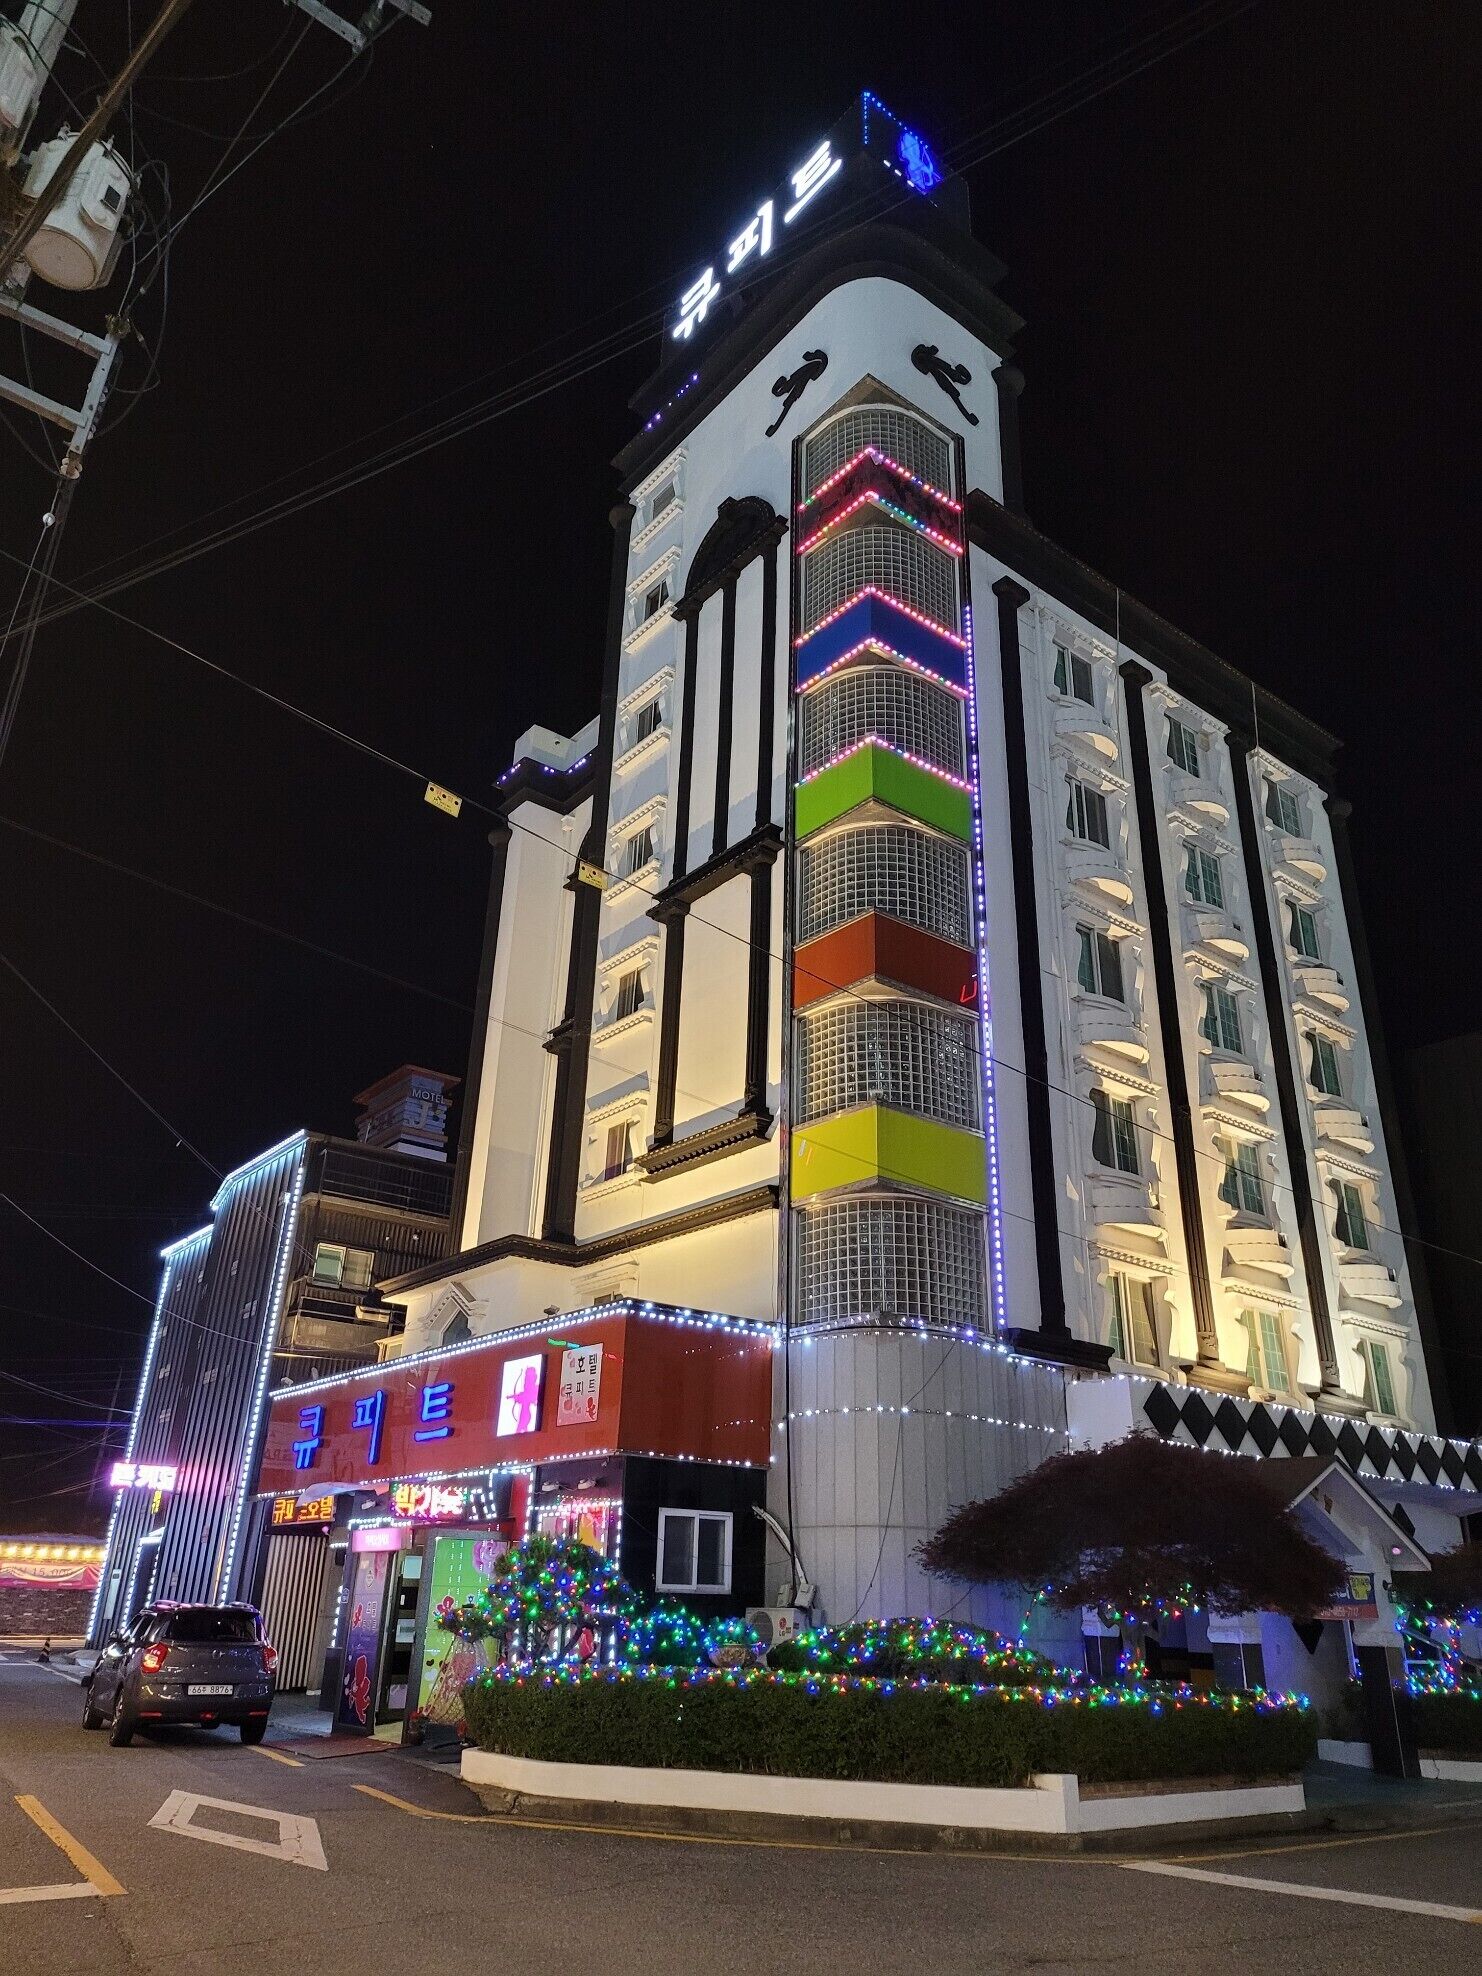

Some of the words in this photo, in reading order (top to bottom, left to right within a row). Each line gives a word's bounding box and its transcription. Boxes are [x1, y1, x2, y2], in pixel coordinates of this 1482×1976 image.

[672, 139, 844, 340] 큐피트
[411, 1087, 446, 1104] MOTEL
[575, 1352, 598, 1376] 호텔
[291, 1381, 456, 1470] 큐피트
[210, 1685, 229, 1694] 8876
